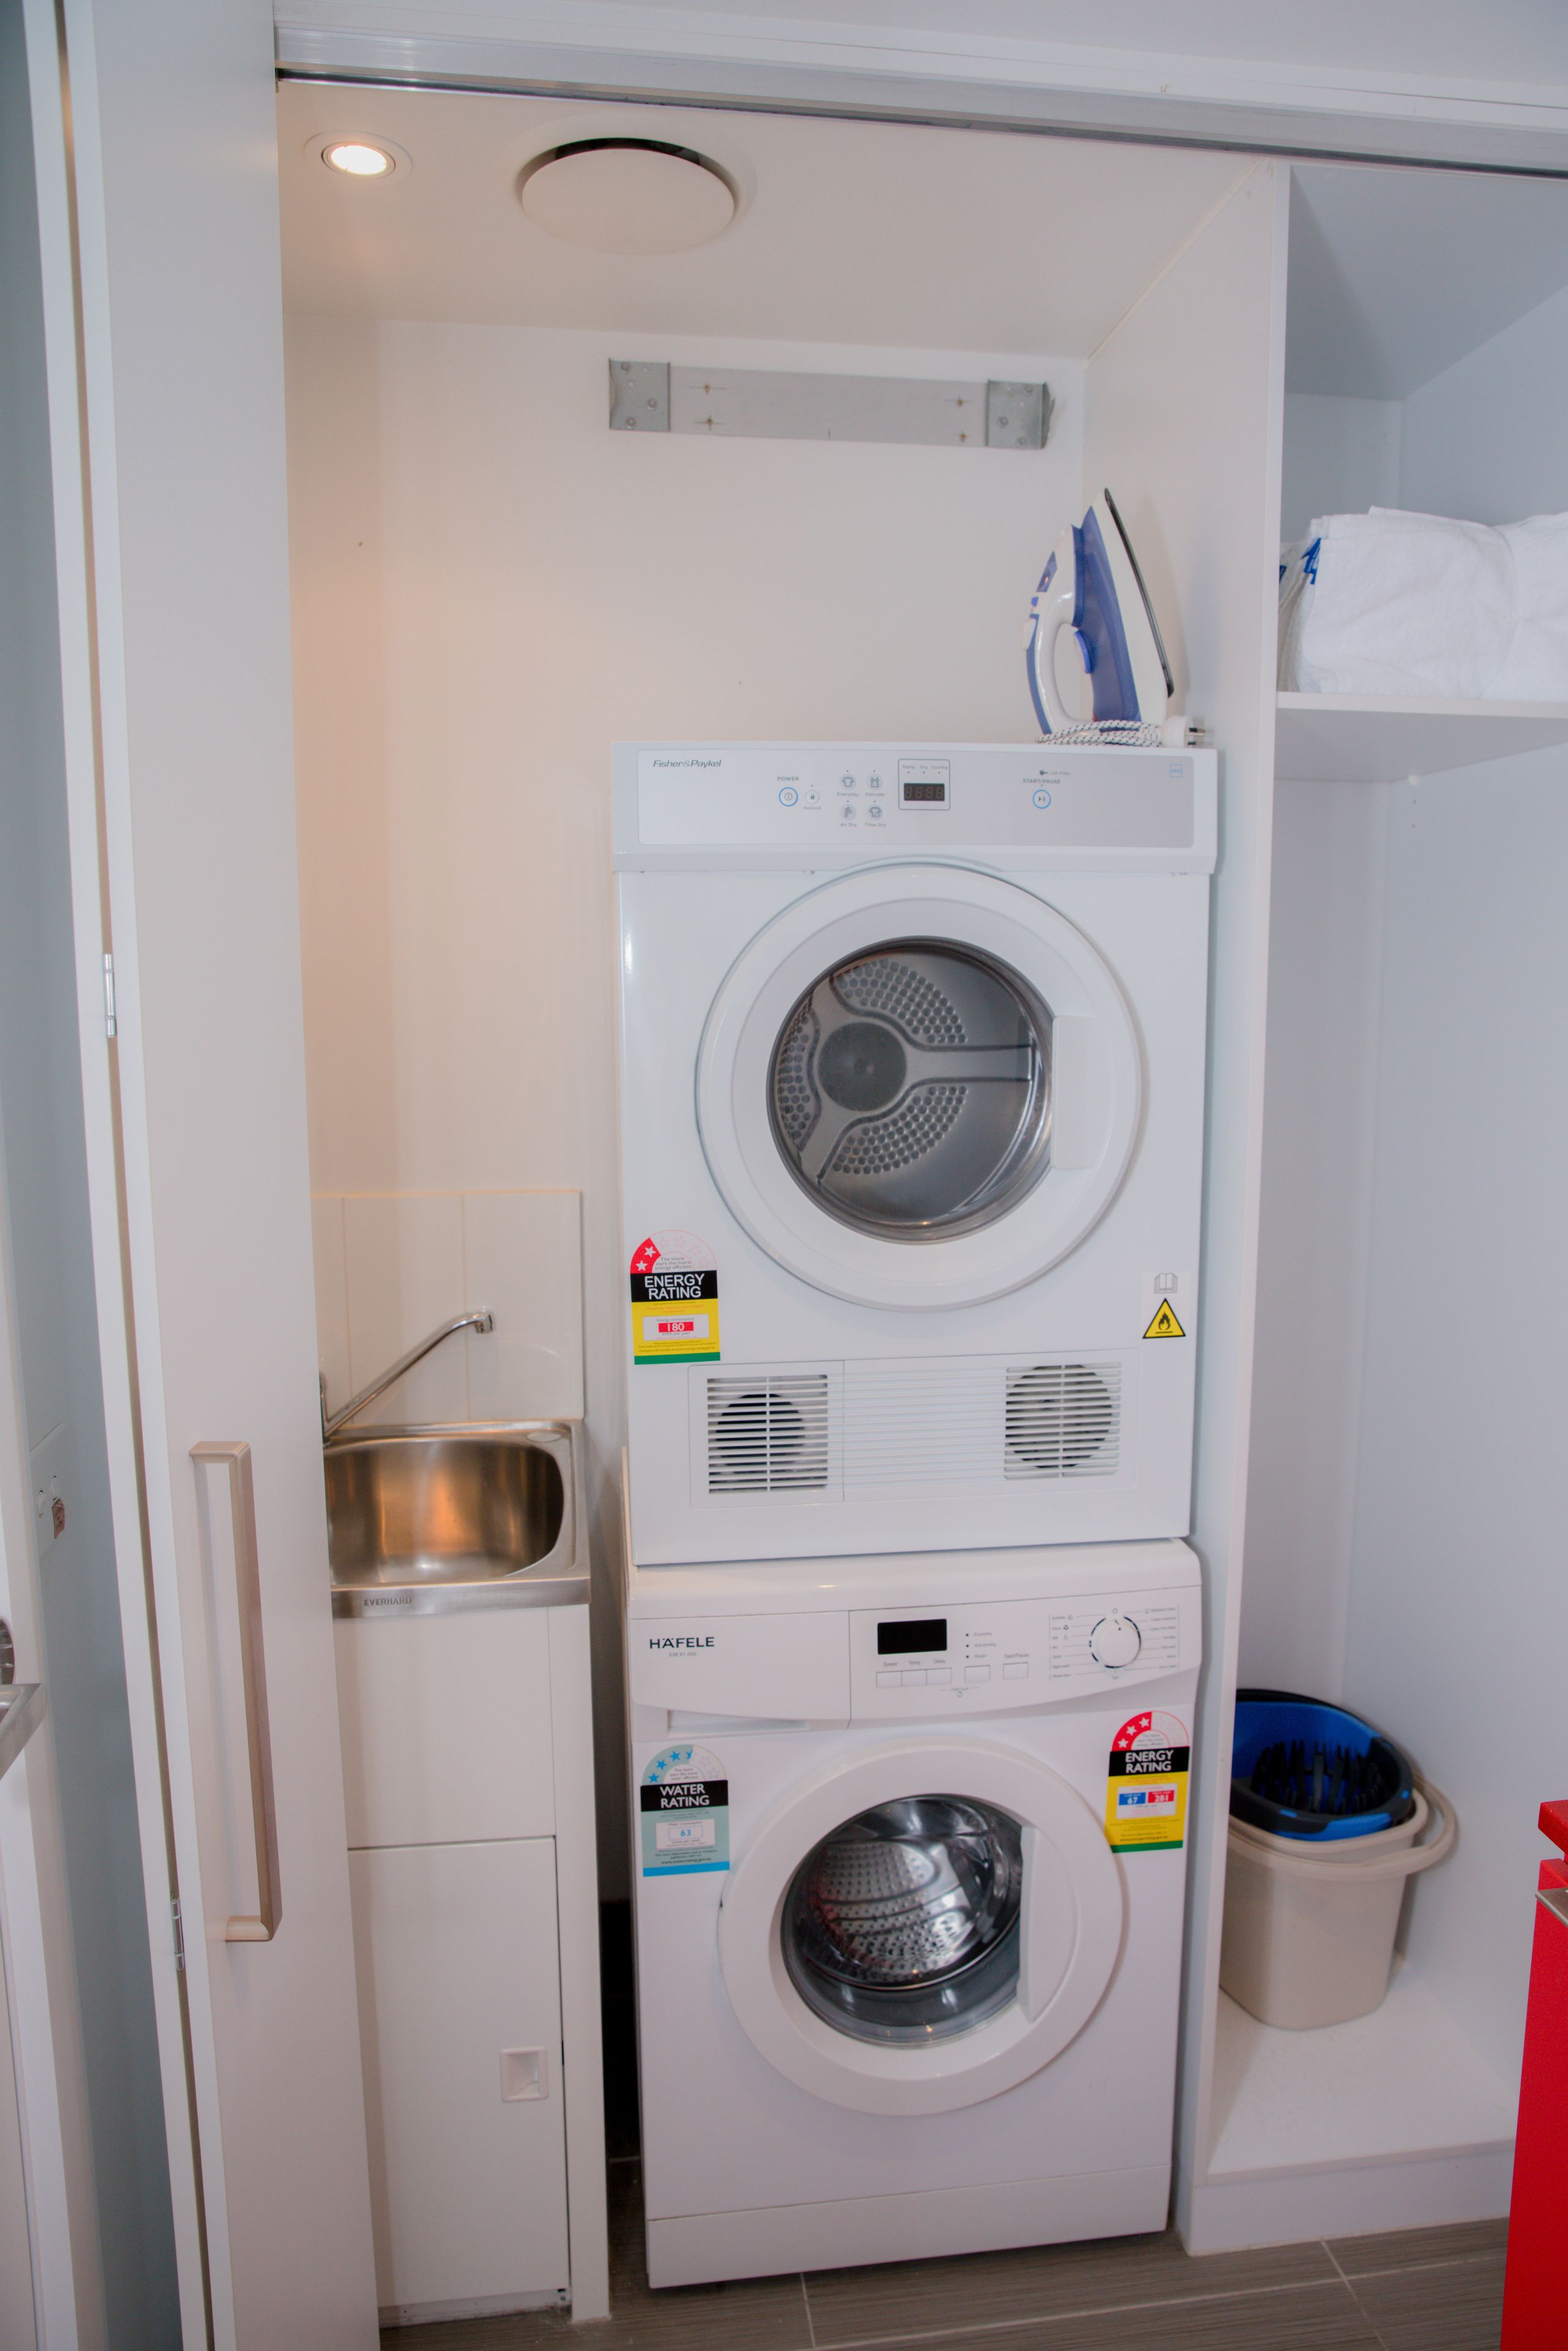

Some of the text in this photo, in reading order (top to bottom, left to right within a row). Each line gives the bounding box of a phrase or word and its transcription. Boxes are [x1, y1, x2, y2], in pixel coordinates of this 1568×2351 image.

[645, 1273, 705, 1288] ENERGY
[648, 1286, 702, 1300] RATING
[667, 1322, 685, 1332] 180
[364, 1597, 411, 1606] EVERHARD
[650, 1637, 715, 1649] HÄFELE
[1125, 1750, 1174, 1763] ENERGY
[1126, 1761, 1172, 1774] RATING
[659, 1783, 706, 1796] WATER
[661, 1795, 710, 1809] RATING
